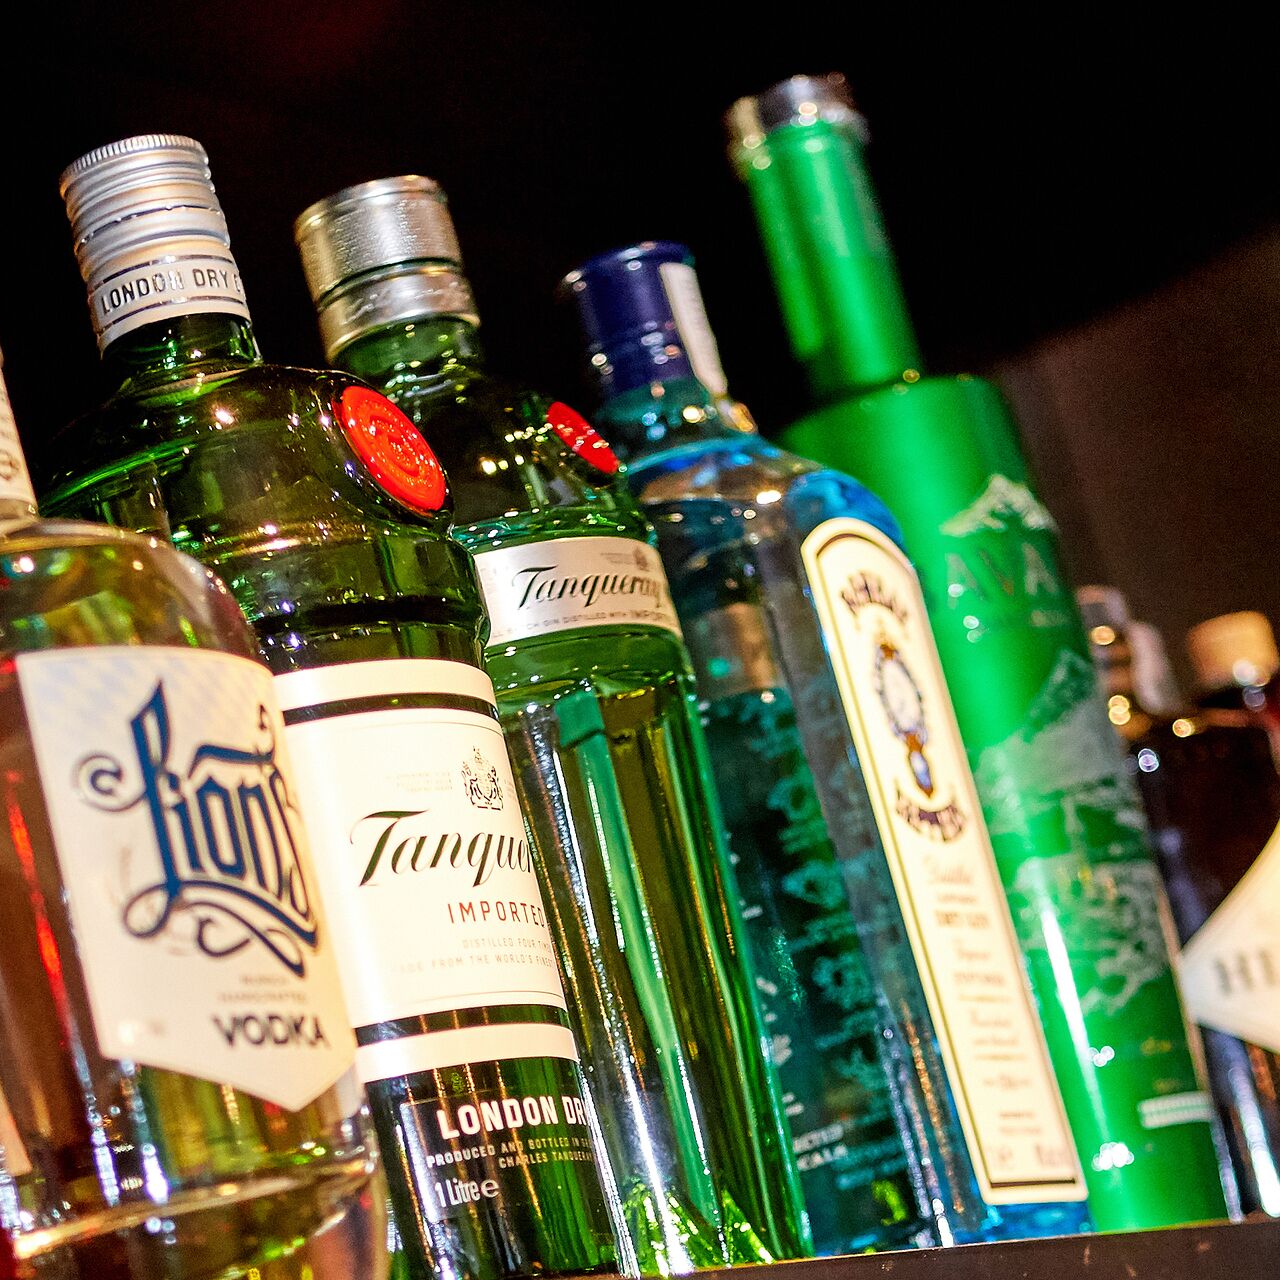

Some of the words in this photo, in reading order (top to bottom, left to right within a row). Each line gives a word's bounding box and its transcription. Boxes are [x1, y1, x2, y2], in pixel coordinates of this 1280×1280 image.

[100, 270, 185, 314] LONDON
[193, 268, 229, 290] DRY
[447, 900, 546, 928] IMPORTED
[463, 937, 513, 949] DISTILLED
[517, 938, 536, 949] FOUR
[470, 954, 489, 965] THE
[496, 953, 533, 964] WORLD'S
[211, 1014, 331, 1049] VODKA
[436, 1095, 558, 1140] LONDON
[427, 1145, 495, 1168] PRODUCED
[501, 1140, 523, 1154] AND
[528, 1137, 570, 1150] BOTTLED
[499, 1152, 548, 1169] CHARLES
[435, 1181, 447, 1208] 1
[447, 1177, 481, 1206] Litre
